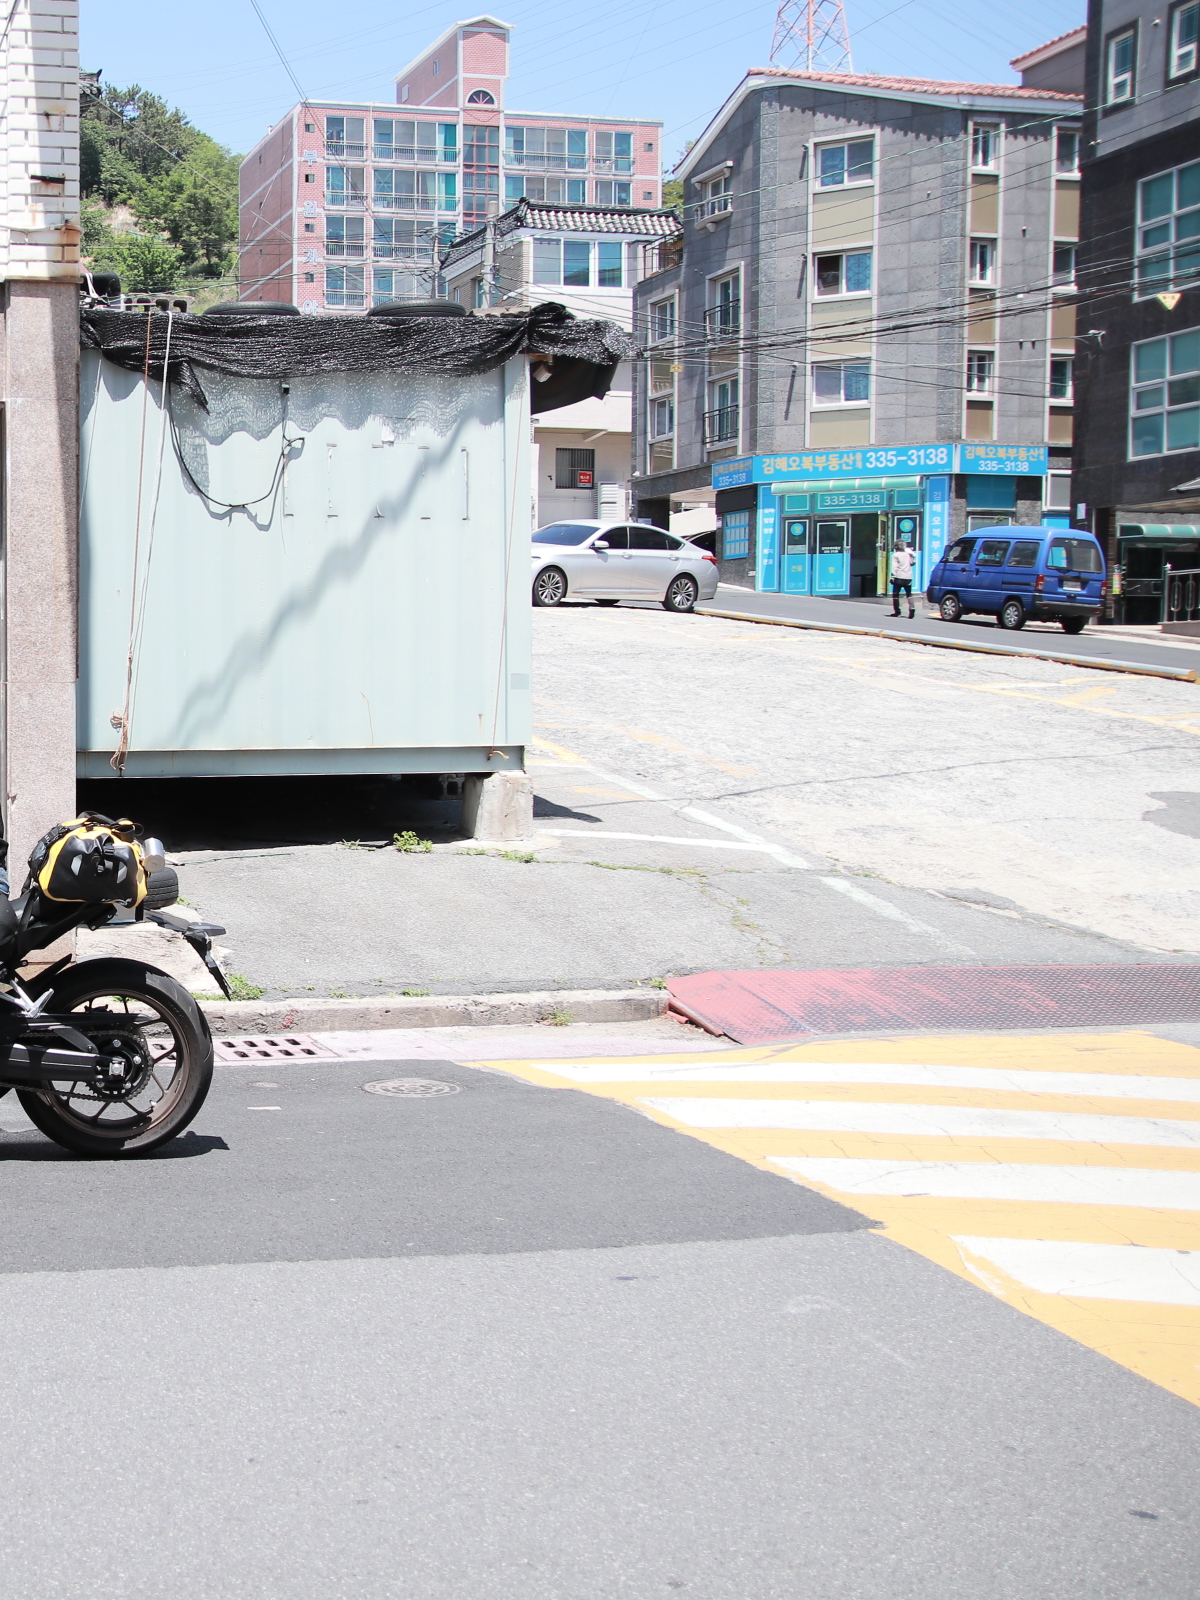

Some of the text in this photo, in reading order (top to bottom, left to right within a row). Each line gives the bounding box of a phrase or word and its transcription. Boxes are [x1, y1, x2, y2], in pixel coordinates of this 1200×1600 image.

[965, 446, 1039, 461] 김해오복부동산
[762, 453, 854, 474] 김해오복부동산
[866, 448, 948, 468] 335-3138
[978, 461, 1029, 472] 335-3138
[719, 473, 746, 486] 335-3138
[824, 494, 881, 505] 335-3138
[932, 491, 942, 570] 김해오복부동
